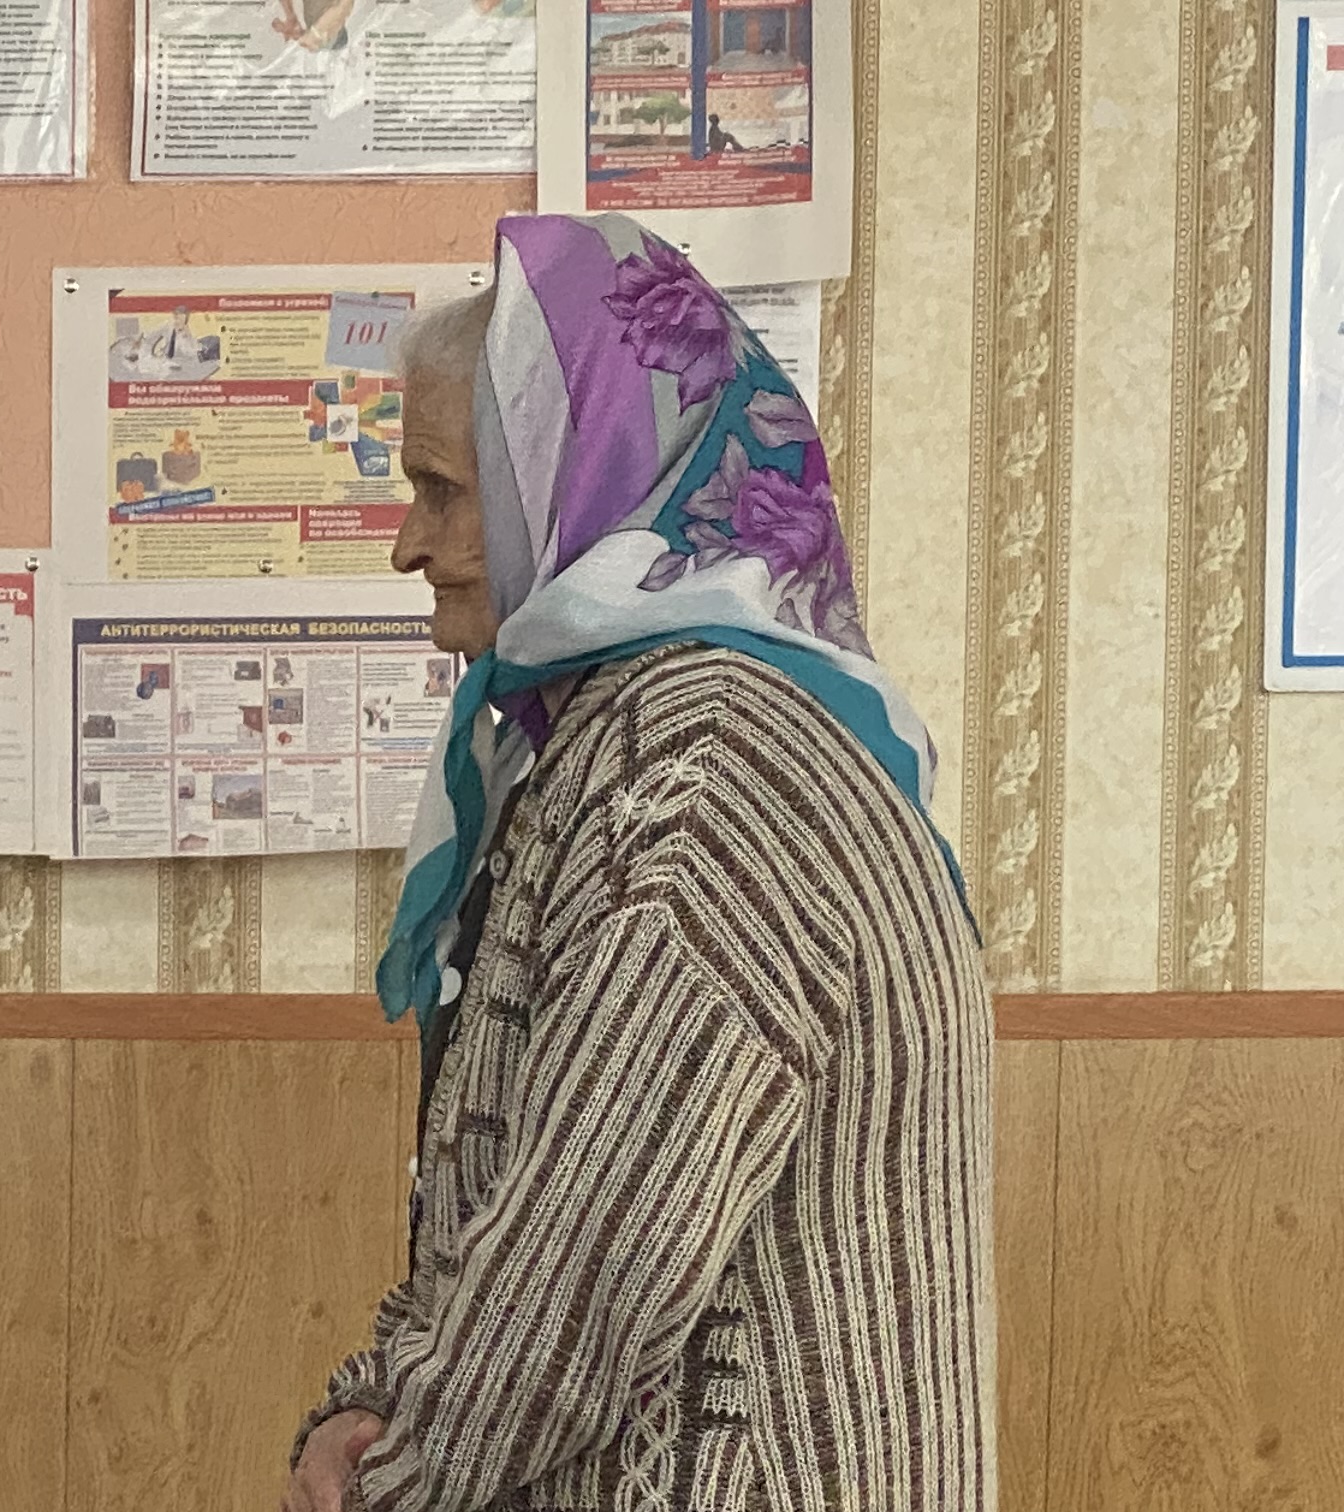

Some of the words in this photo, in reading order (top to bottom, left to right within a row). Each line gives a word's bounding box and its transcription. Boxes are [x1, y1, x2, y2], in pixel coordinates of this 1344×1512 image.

[343, 319, 389, 346] 101
[100, 622, 301, 637] АНТИТЕРРОРИСТИЧЕСКАЯ
[308, 621, 433, 636] БЕЗОПАСНОСТЬ
